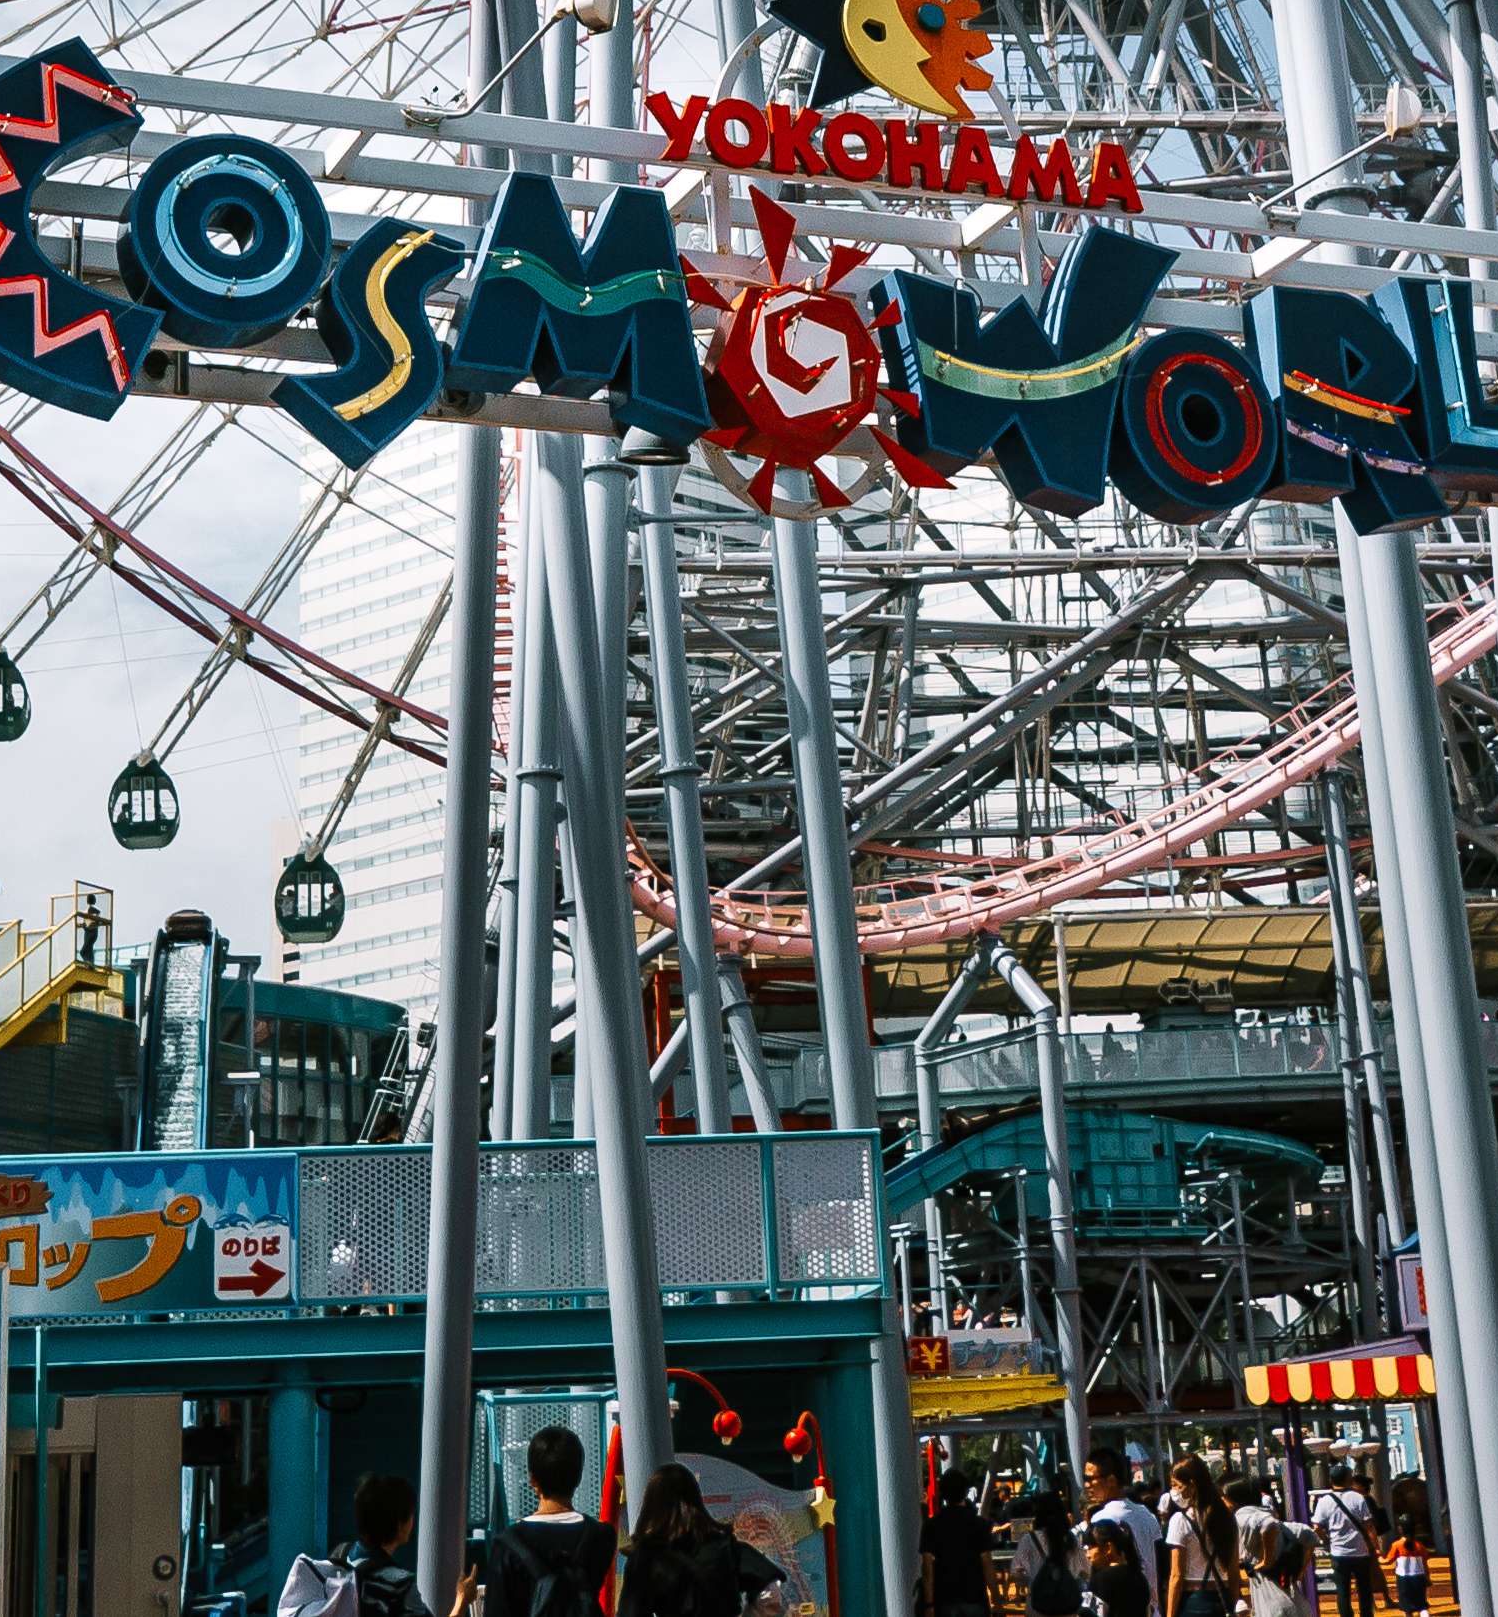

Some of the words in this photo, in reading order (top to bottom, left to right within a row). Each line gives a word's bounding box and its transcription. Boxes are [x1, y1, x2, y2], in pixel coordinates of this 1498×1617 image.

[643, 89, 1145, 214] YOKOHAMA
[221, 1235, 281, 1257] のりば
